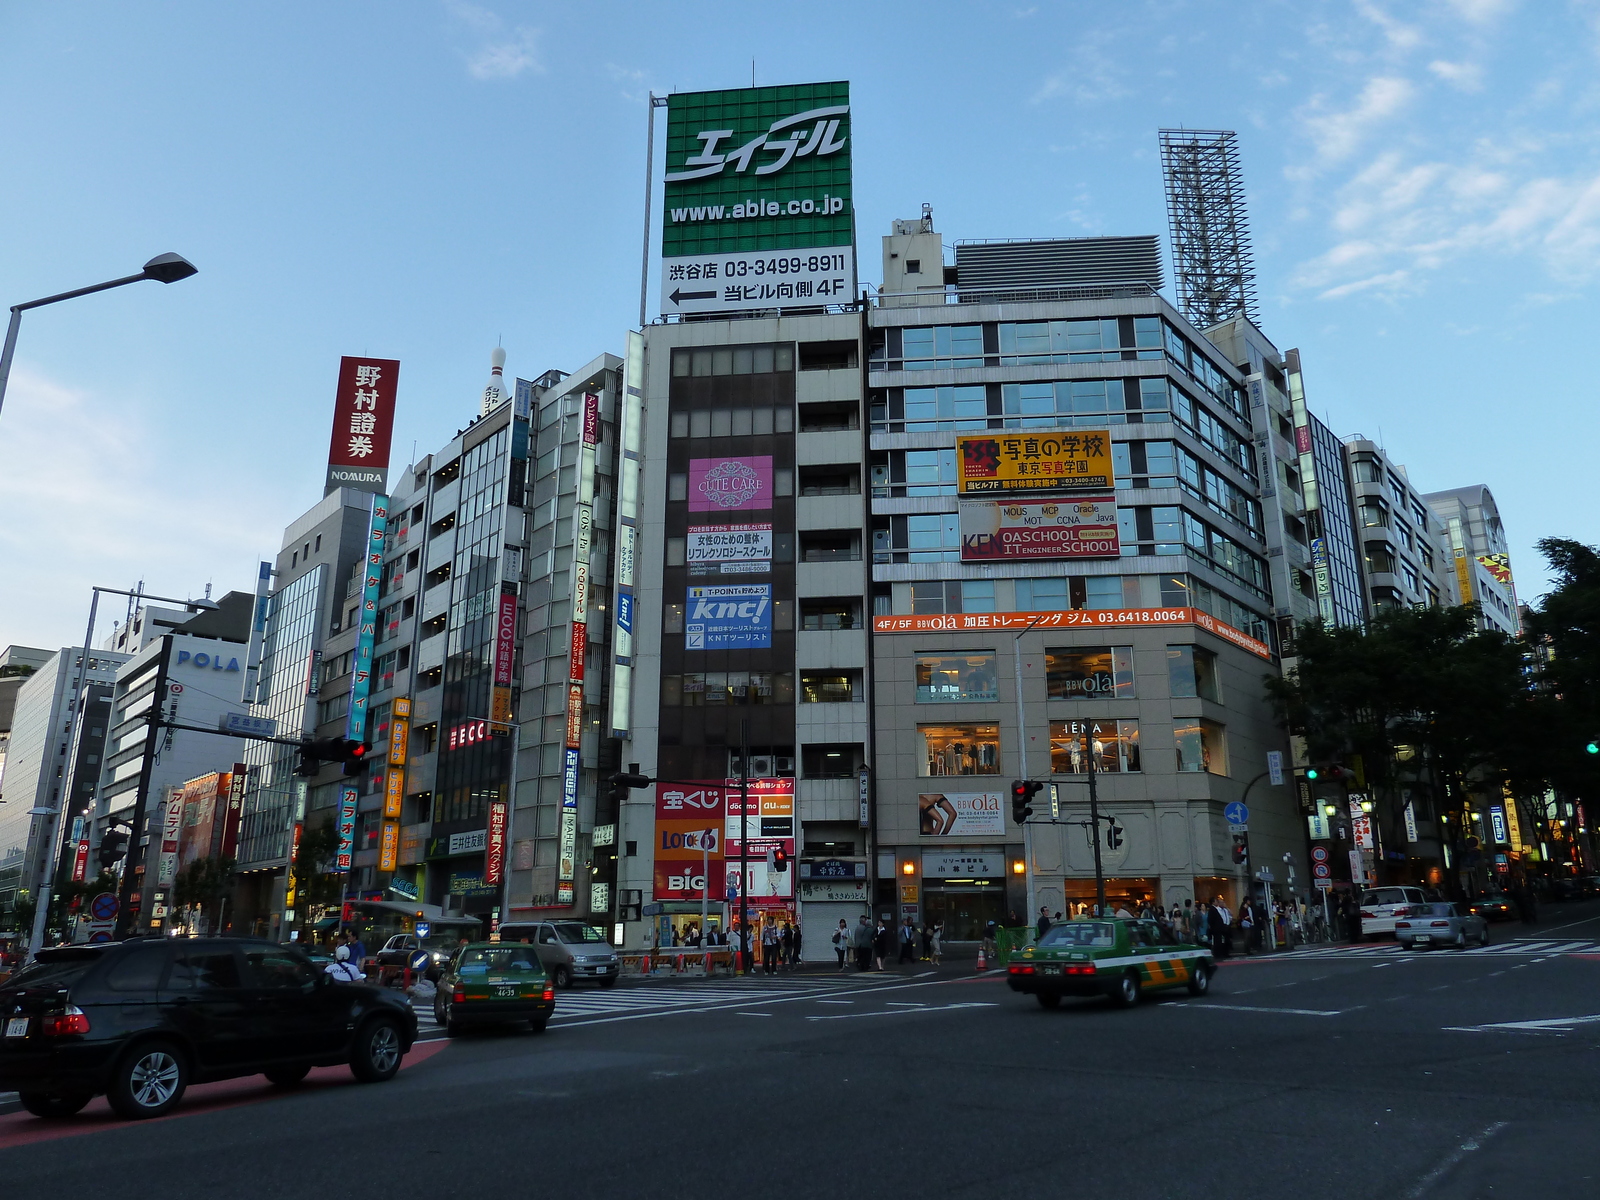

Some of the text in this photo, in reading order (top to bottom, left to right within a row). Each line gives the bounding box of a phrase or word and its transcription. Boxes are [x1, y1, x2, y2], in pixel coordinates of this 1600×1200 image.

[668, 112, 850, 180] エイブル
[670, 194, 844, 223] www.able.co.jp
[669, 254, 845, 282] 渋谷店 03-3499-8911
[347, 365, 382, 458] 野村證券
[1002, 435, 1104, 461] 写真の学校
[331, 471, 383, 483] NOMURA
[1017, 460, 1089, 475] 東京写真学園
[698, 477, 763, 492] CUTE CARE
[967, 479, 1058, 490] 当ビル7F 無料体験実施中
[1003, 503, 1100, 516] MOUS MCP Oracle
[1024, 513, 1115, 525] MOT CCNA Java
[688, 545, 771, 560] リフレクソロジースクール
[963, 533, 1003, 555] KEN
[1004, 541, 1118, 555] IT ENGINEER SCHOOL
[692, 595, 770, 624] knt!
[1098, 610, 1186, 623] 03.6418.0064
[498, 602, 513, 682] ECC外語学院
[707, 634, 767, 642] KNTツーリスト
[177, 650, 240, 672] POLA
[392, 723, 403, 761] カラオケ
[459, 722, 485, 744] ECC
[229, 774, 243, 810] 野村證券
[387, 771, 399, 814] ビリヤード
[662, 789, 719, 810] 宝くじ
[729, 801, 757, 810] docmo
[763, 801, 777, 810] au
[337, 790, 357, 867] カラオケ館
[382, 824, 394, 867] ボウリング
[1315, 850, 1324, 859] 40
[667, 875, 706, 891] BIG
